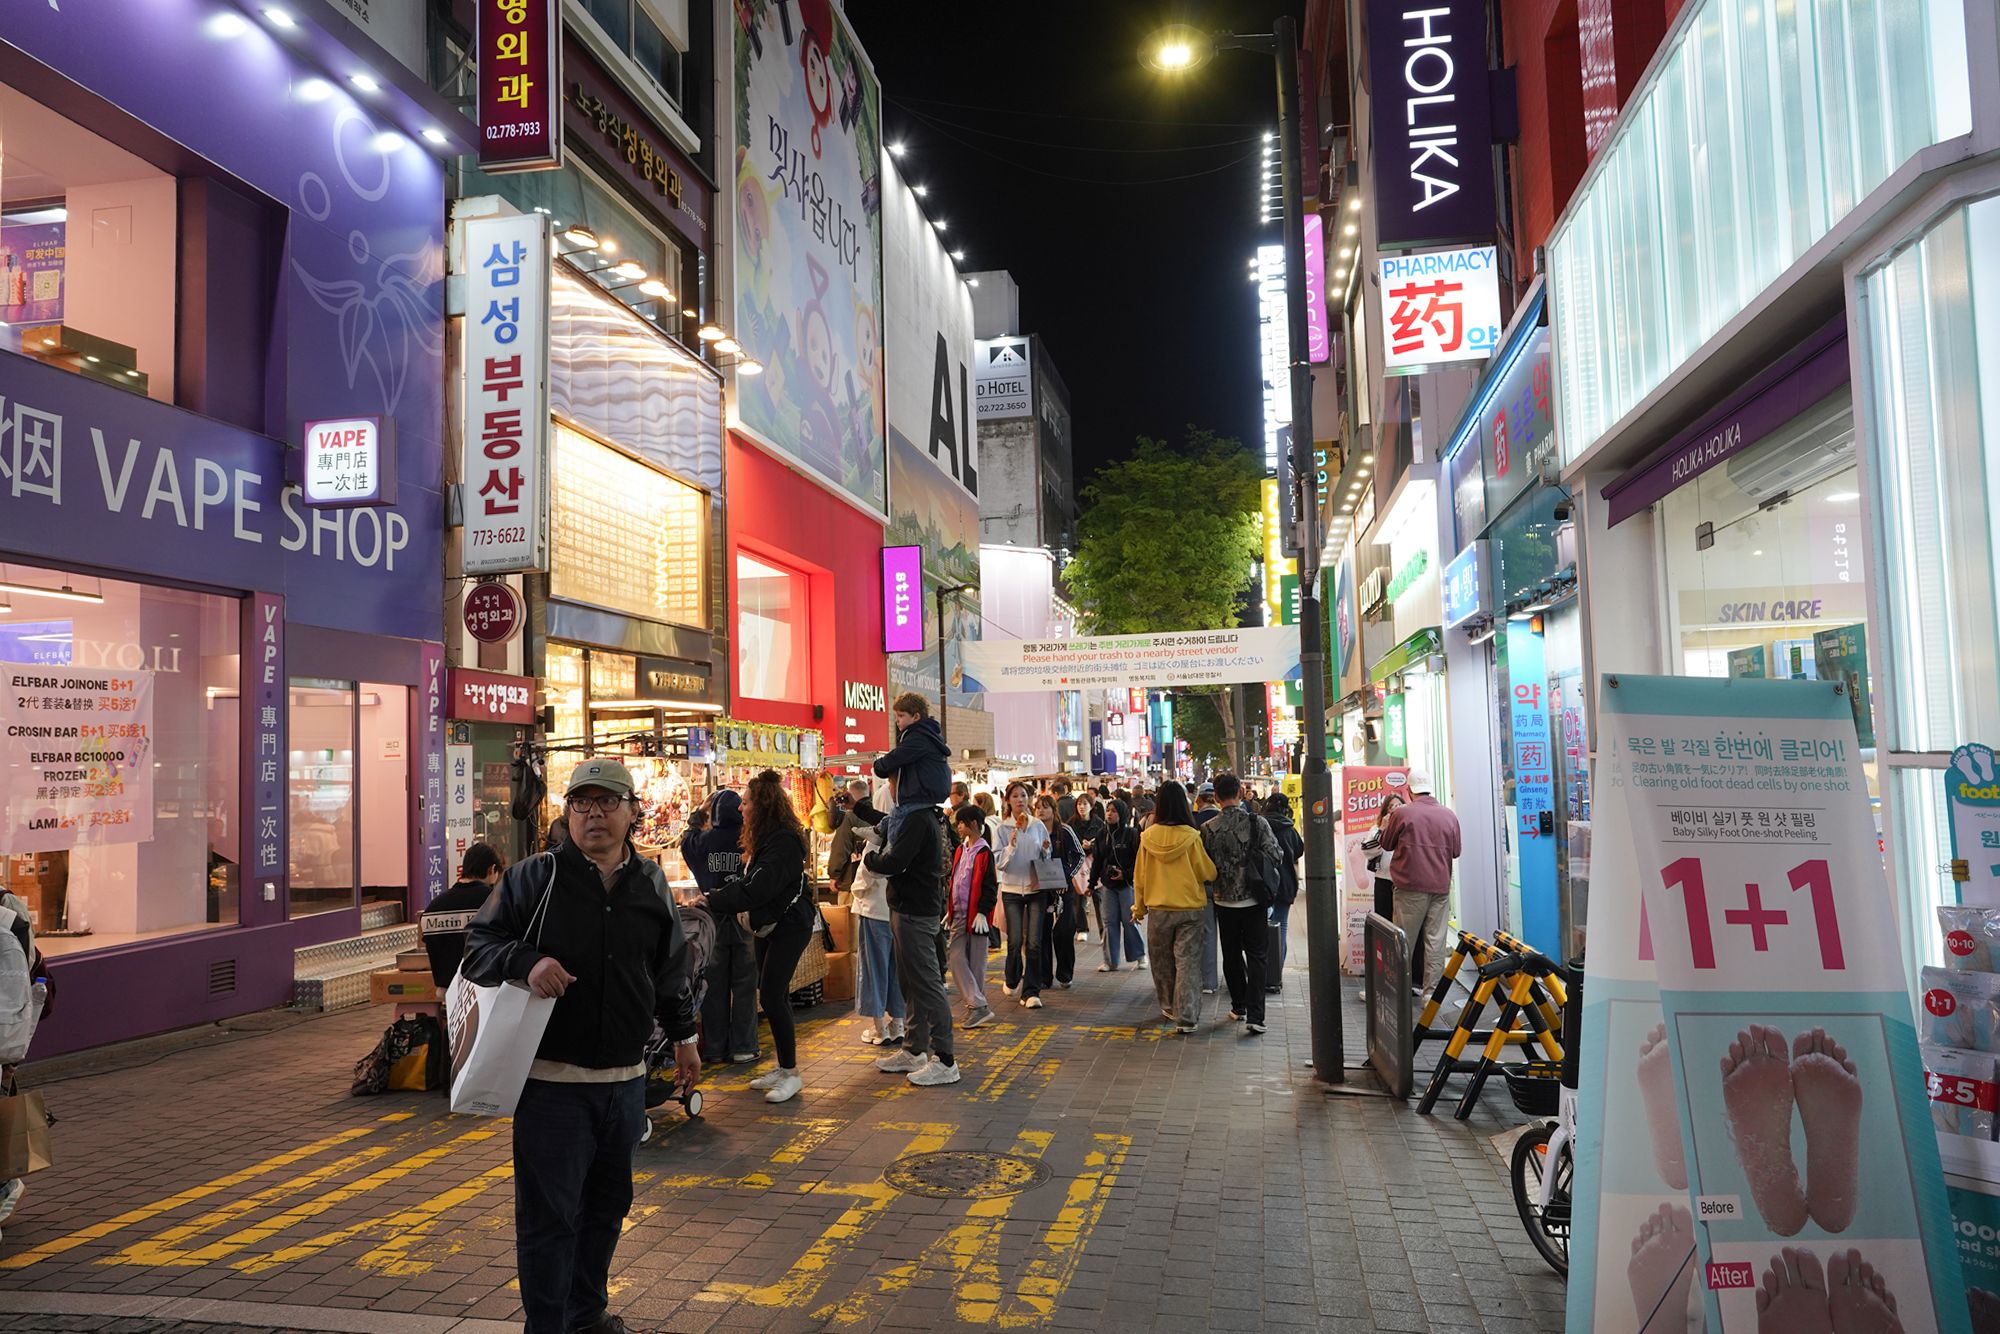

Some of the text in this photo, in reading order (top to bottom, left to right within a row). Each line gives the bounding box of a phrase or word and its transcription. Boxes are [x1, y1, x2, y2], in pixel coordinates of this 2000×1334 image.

[1402, 7, 1460, 212] HOLIKA
[486, 121, 541, 140] 02.778-7933
[623, 123, 683, 208] 성형외과
[1384, 250, 1494, 279] PHARMACY
[1389, 279, 1463, 355] 药
[1467, 326, 1499, 353] 약
[480, 240, 527, 517] 삼성부동산
[988, 380, 1024, 395] HOTEL
[318, 428, 367, 449] VAPE
[317, 451, 369, 472] 專門店
[1672, 422, 1741, 484] HOLIKA HOLIKA
[316, 473, 369, 492] 一次性
[90, 427, 410, 571] VAPE SHOP
[472, 527, 526, 546] 773-6622
[895, 572, 910, 627] stila
[467, 609, 513, 632] 성형외과
[1718, 600, 1822, 622] SKIN CARE
[1023, 642, 1038, 653] 명동
[1039, 641, 1068, 652] 거리가게
[1152, 636, 1176, 647] 주시면
[1176, 635, 1207, 646] 수거하여
[1207, 633, 1239, 645] 드립니다
[1023, 644, 1239, 663] Please hand your trash to a nearby street vendor
[12, 676, 133, 692] ELFBAR JOINONE 5+1
[428, 658, 441, 733] VAPE
[486, 683, 528, 714] 성형외과
[844, 680, 886, 712] MISSHA
[1514, 683, 1541, 710] 약
[54, 727, 78, 738] BAR
[80, 725, 105, 738] 5+1
[260, 604, 278, 867] VAPE 專門店 一次性
[1514, 730, 1546, 739] Pharmacy
[31, 752, 72, 763] ELFBAR
[1519, 744, 1542, 767] 药
[1628, 736, 1846, 763] 묵은 발 각질 한번에 클리어!
[44, 771, 88, 782] FROZEN
[454, 757, 467, 805] 삼성
[1348, 776, 1383, 795] Foot
[1633, 776, 1850, 793] Clearing old foot dead cells by one shot
[1519, 786, 1548, 795] Ginseng
[28, 818, 58, 831] LAMI
[1521, 814, 1537, 826] 1F
[1671, 811, 1816, 828] 베이비 실키 풋 원 샷 필링
[1672, 827, 1818, 841] Baby Silky Foot One-shot Peeling
[426, 918, 461, 929] Matin
[1660, 857, 1846, 970] 1+1
[1947, 938, 1975, 950] 10+10
[1929, 995, 1952, 1010] 1+1
[1927, 1072, 1976, 1104] 5+5
[1701, 1201, 1735, 1214] Before
[1711, 1266, 1749, 1287] After
